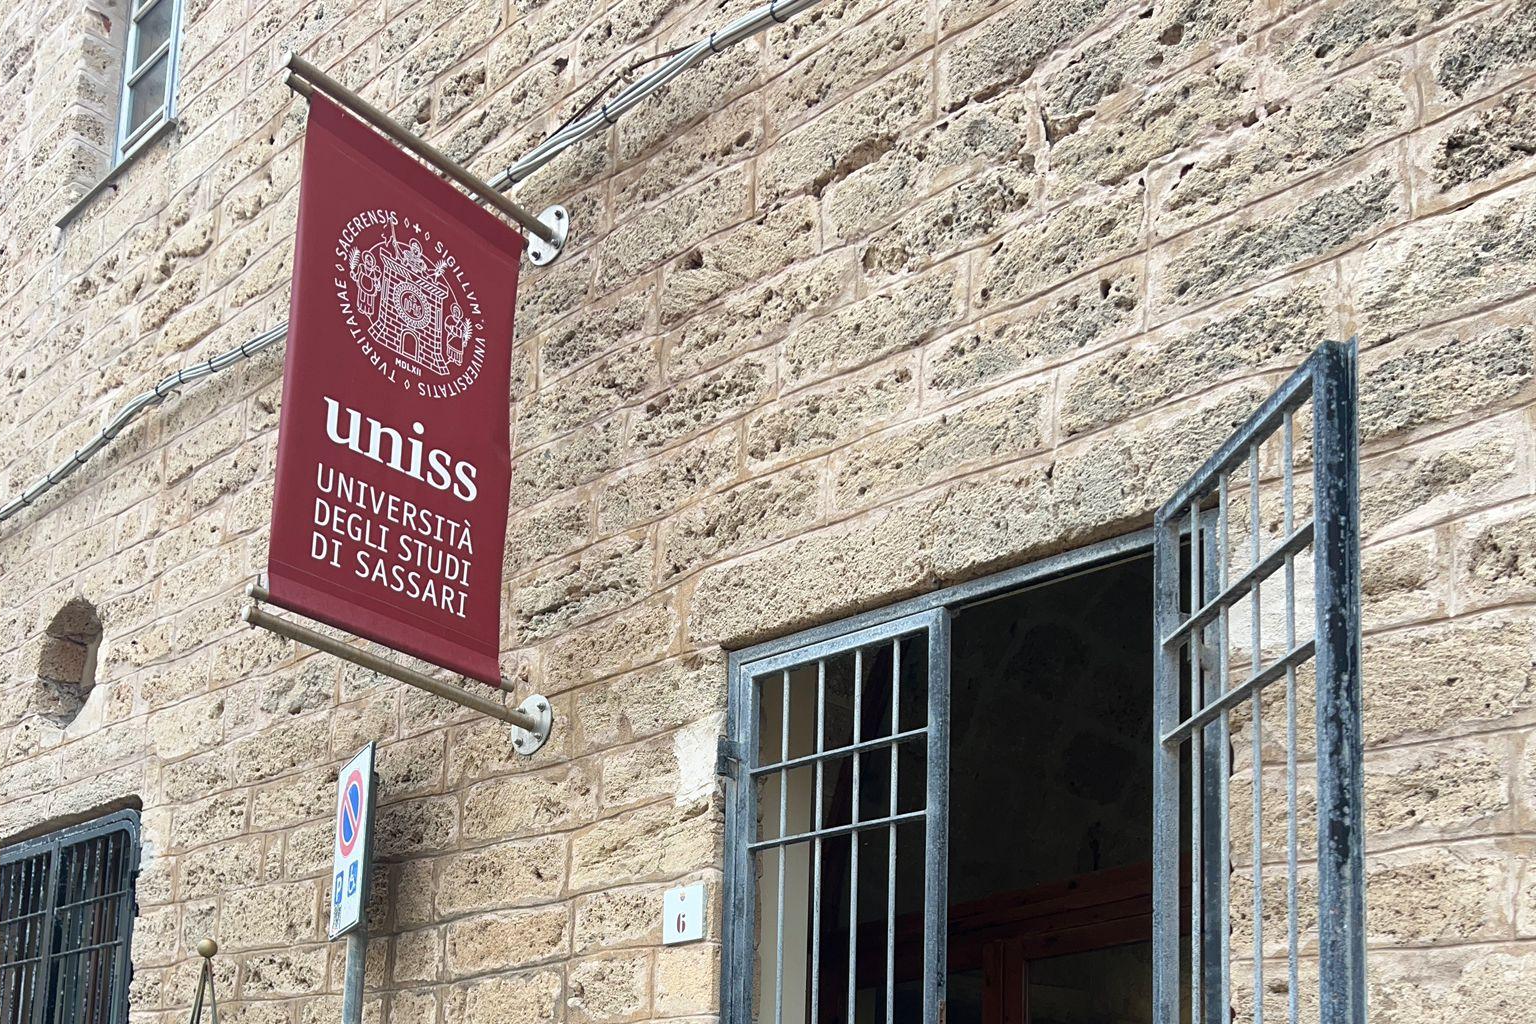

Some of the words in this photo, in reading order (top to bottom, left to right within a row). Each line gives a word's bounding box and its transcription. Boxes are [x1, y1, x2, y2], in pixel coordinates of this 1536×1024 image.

[335, 209, 398, 261] SACERENSIS
[434, 241, 481, 315] SIGILLVM
[334, 277, 396, 383] TVRRITANAE
[395, 357, 422, 377] MDLXII
[418, 337, 486, 399] VNIVERSITATIS
[323, 396, 478, 502] uniss
[314, 497, 389, 553] DEGLI
[398, 534, 472, 587] STUDI
[316, 462, 473, 554] UNIVERSITÀ
[311, 531, 343, 568] DI
[355, 550, 469, 618] SASSARI
[676, 912, 686, 934] 6
